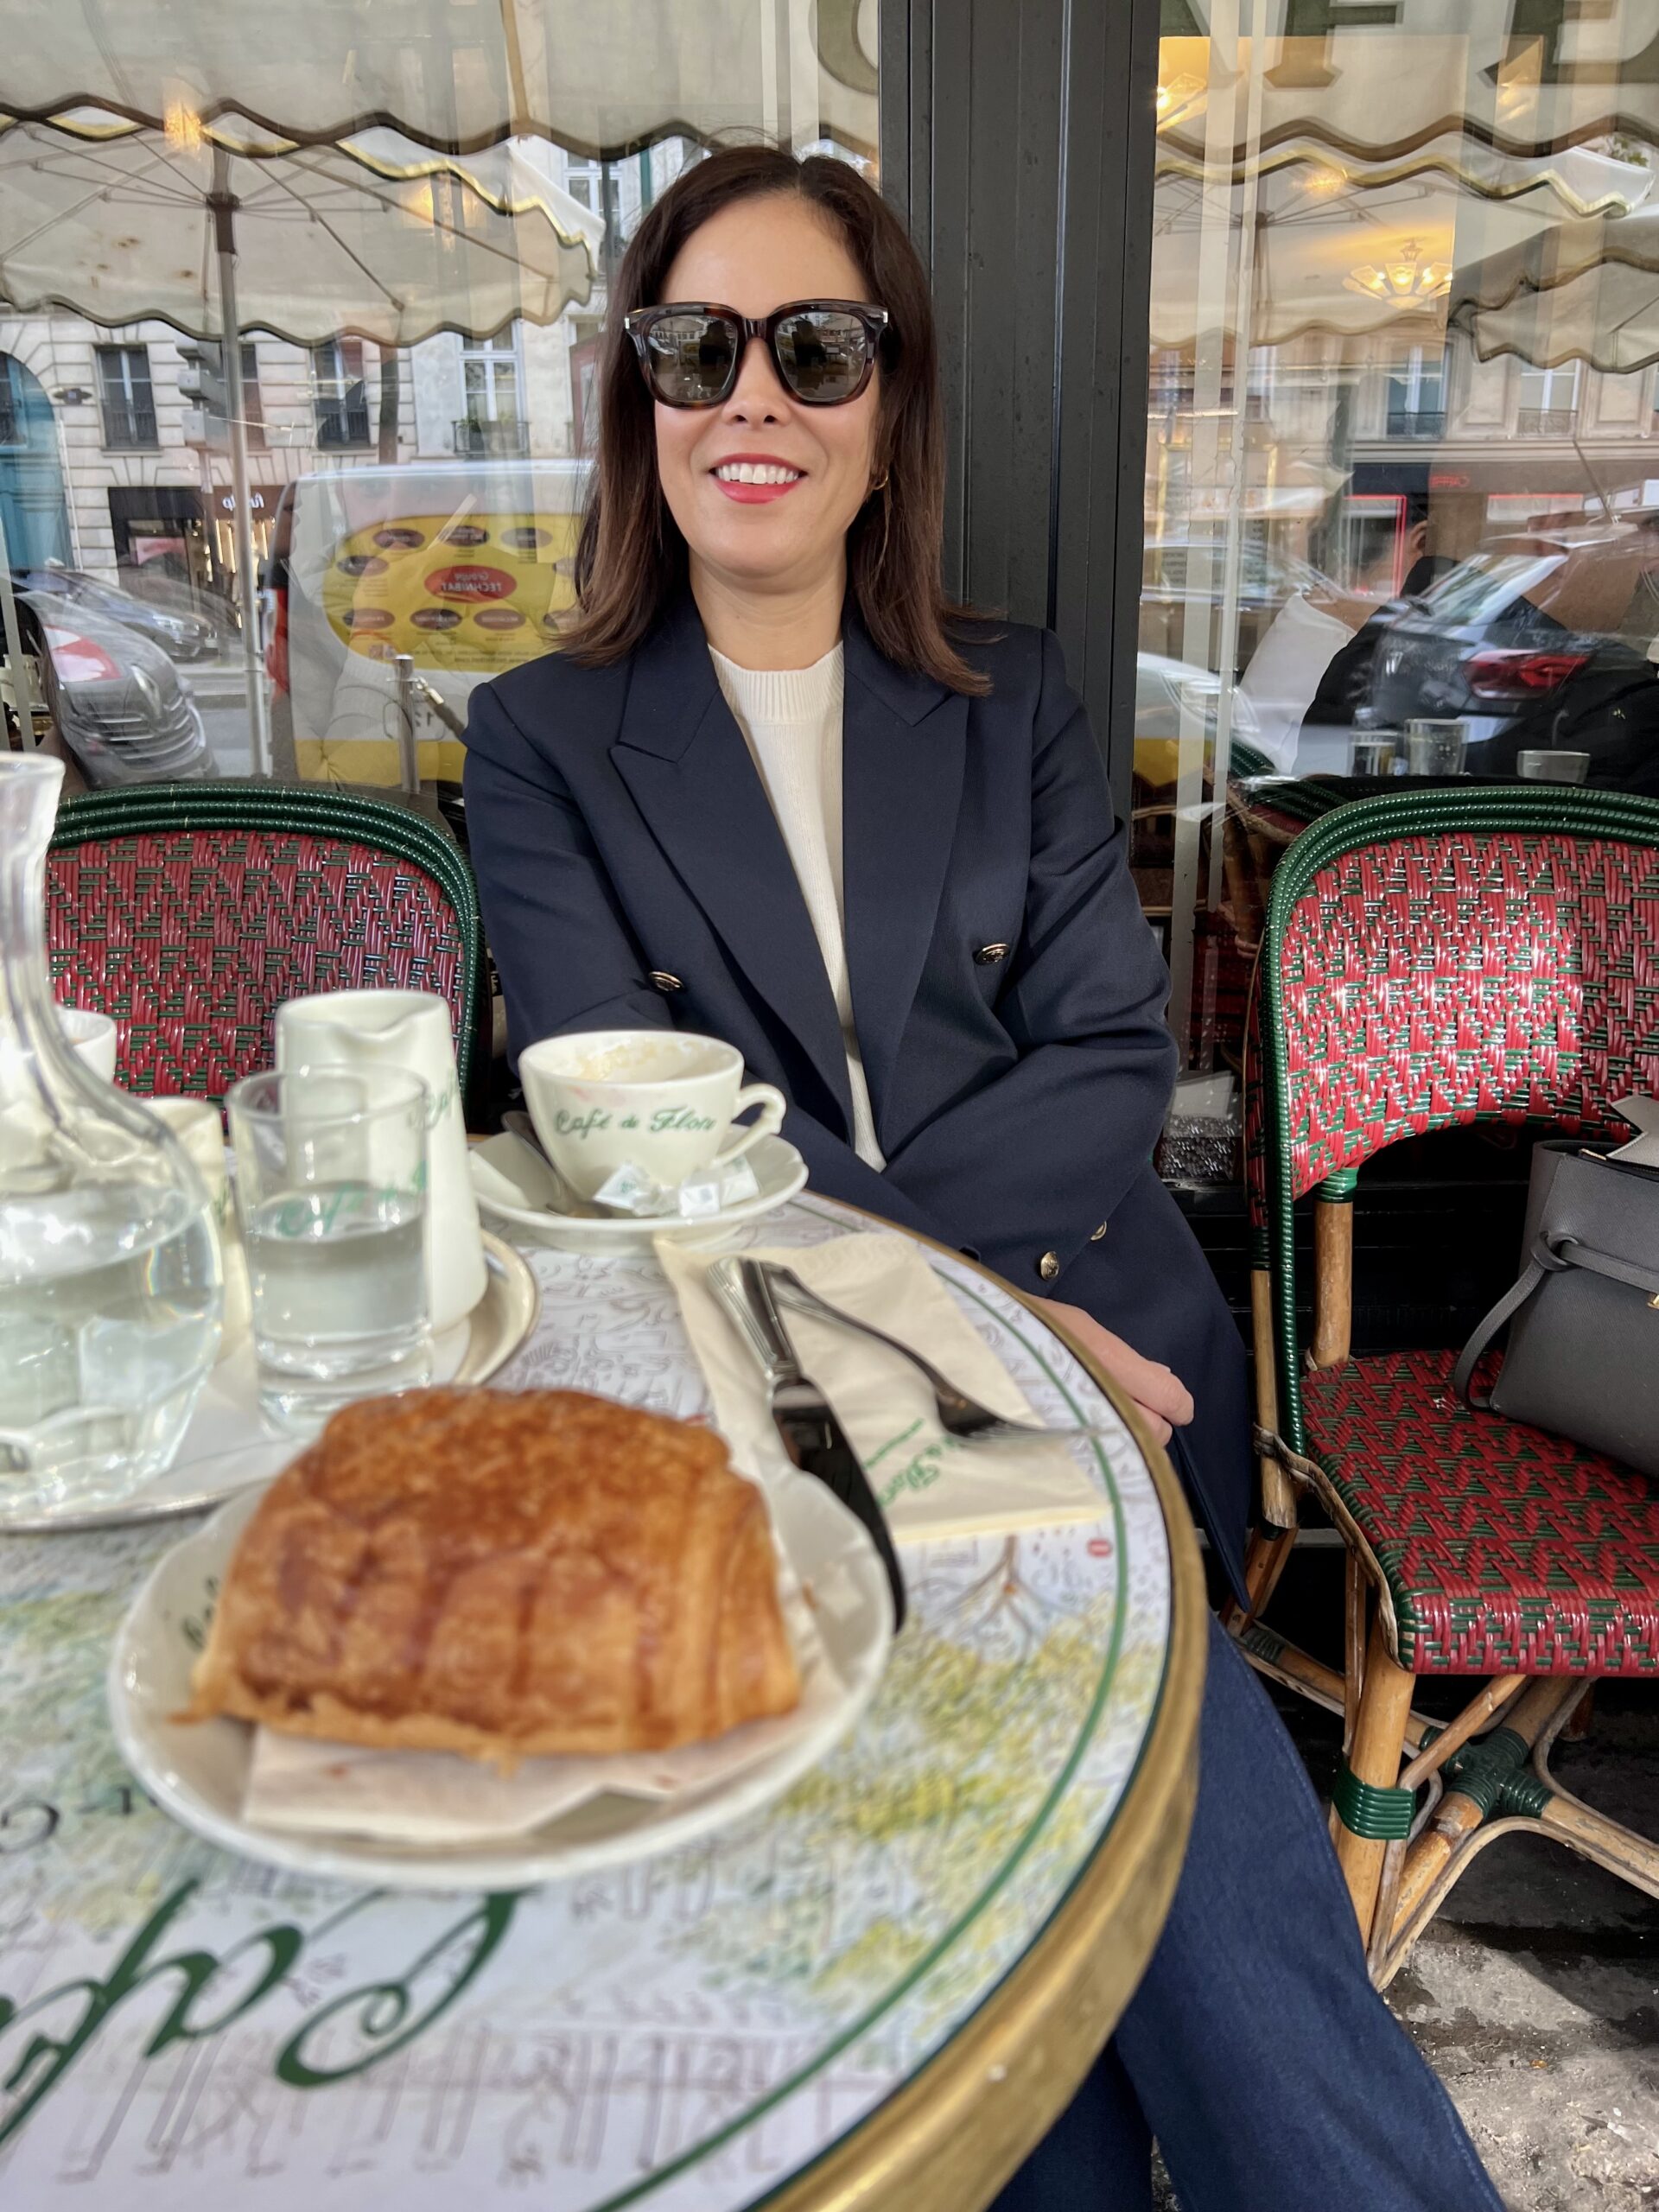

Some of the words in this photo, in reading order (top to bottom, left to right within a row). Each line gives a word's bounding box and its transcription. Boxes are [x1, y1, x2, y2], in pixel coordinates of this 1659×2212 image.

[555, 1108, 613, 1140] Café
[620, 1114, 639, 1129] de
[0, 1878, 543, 2145] Caf
